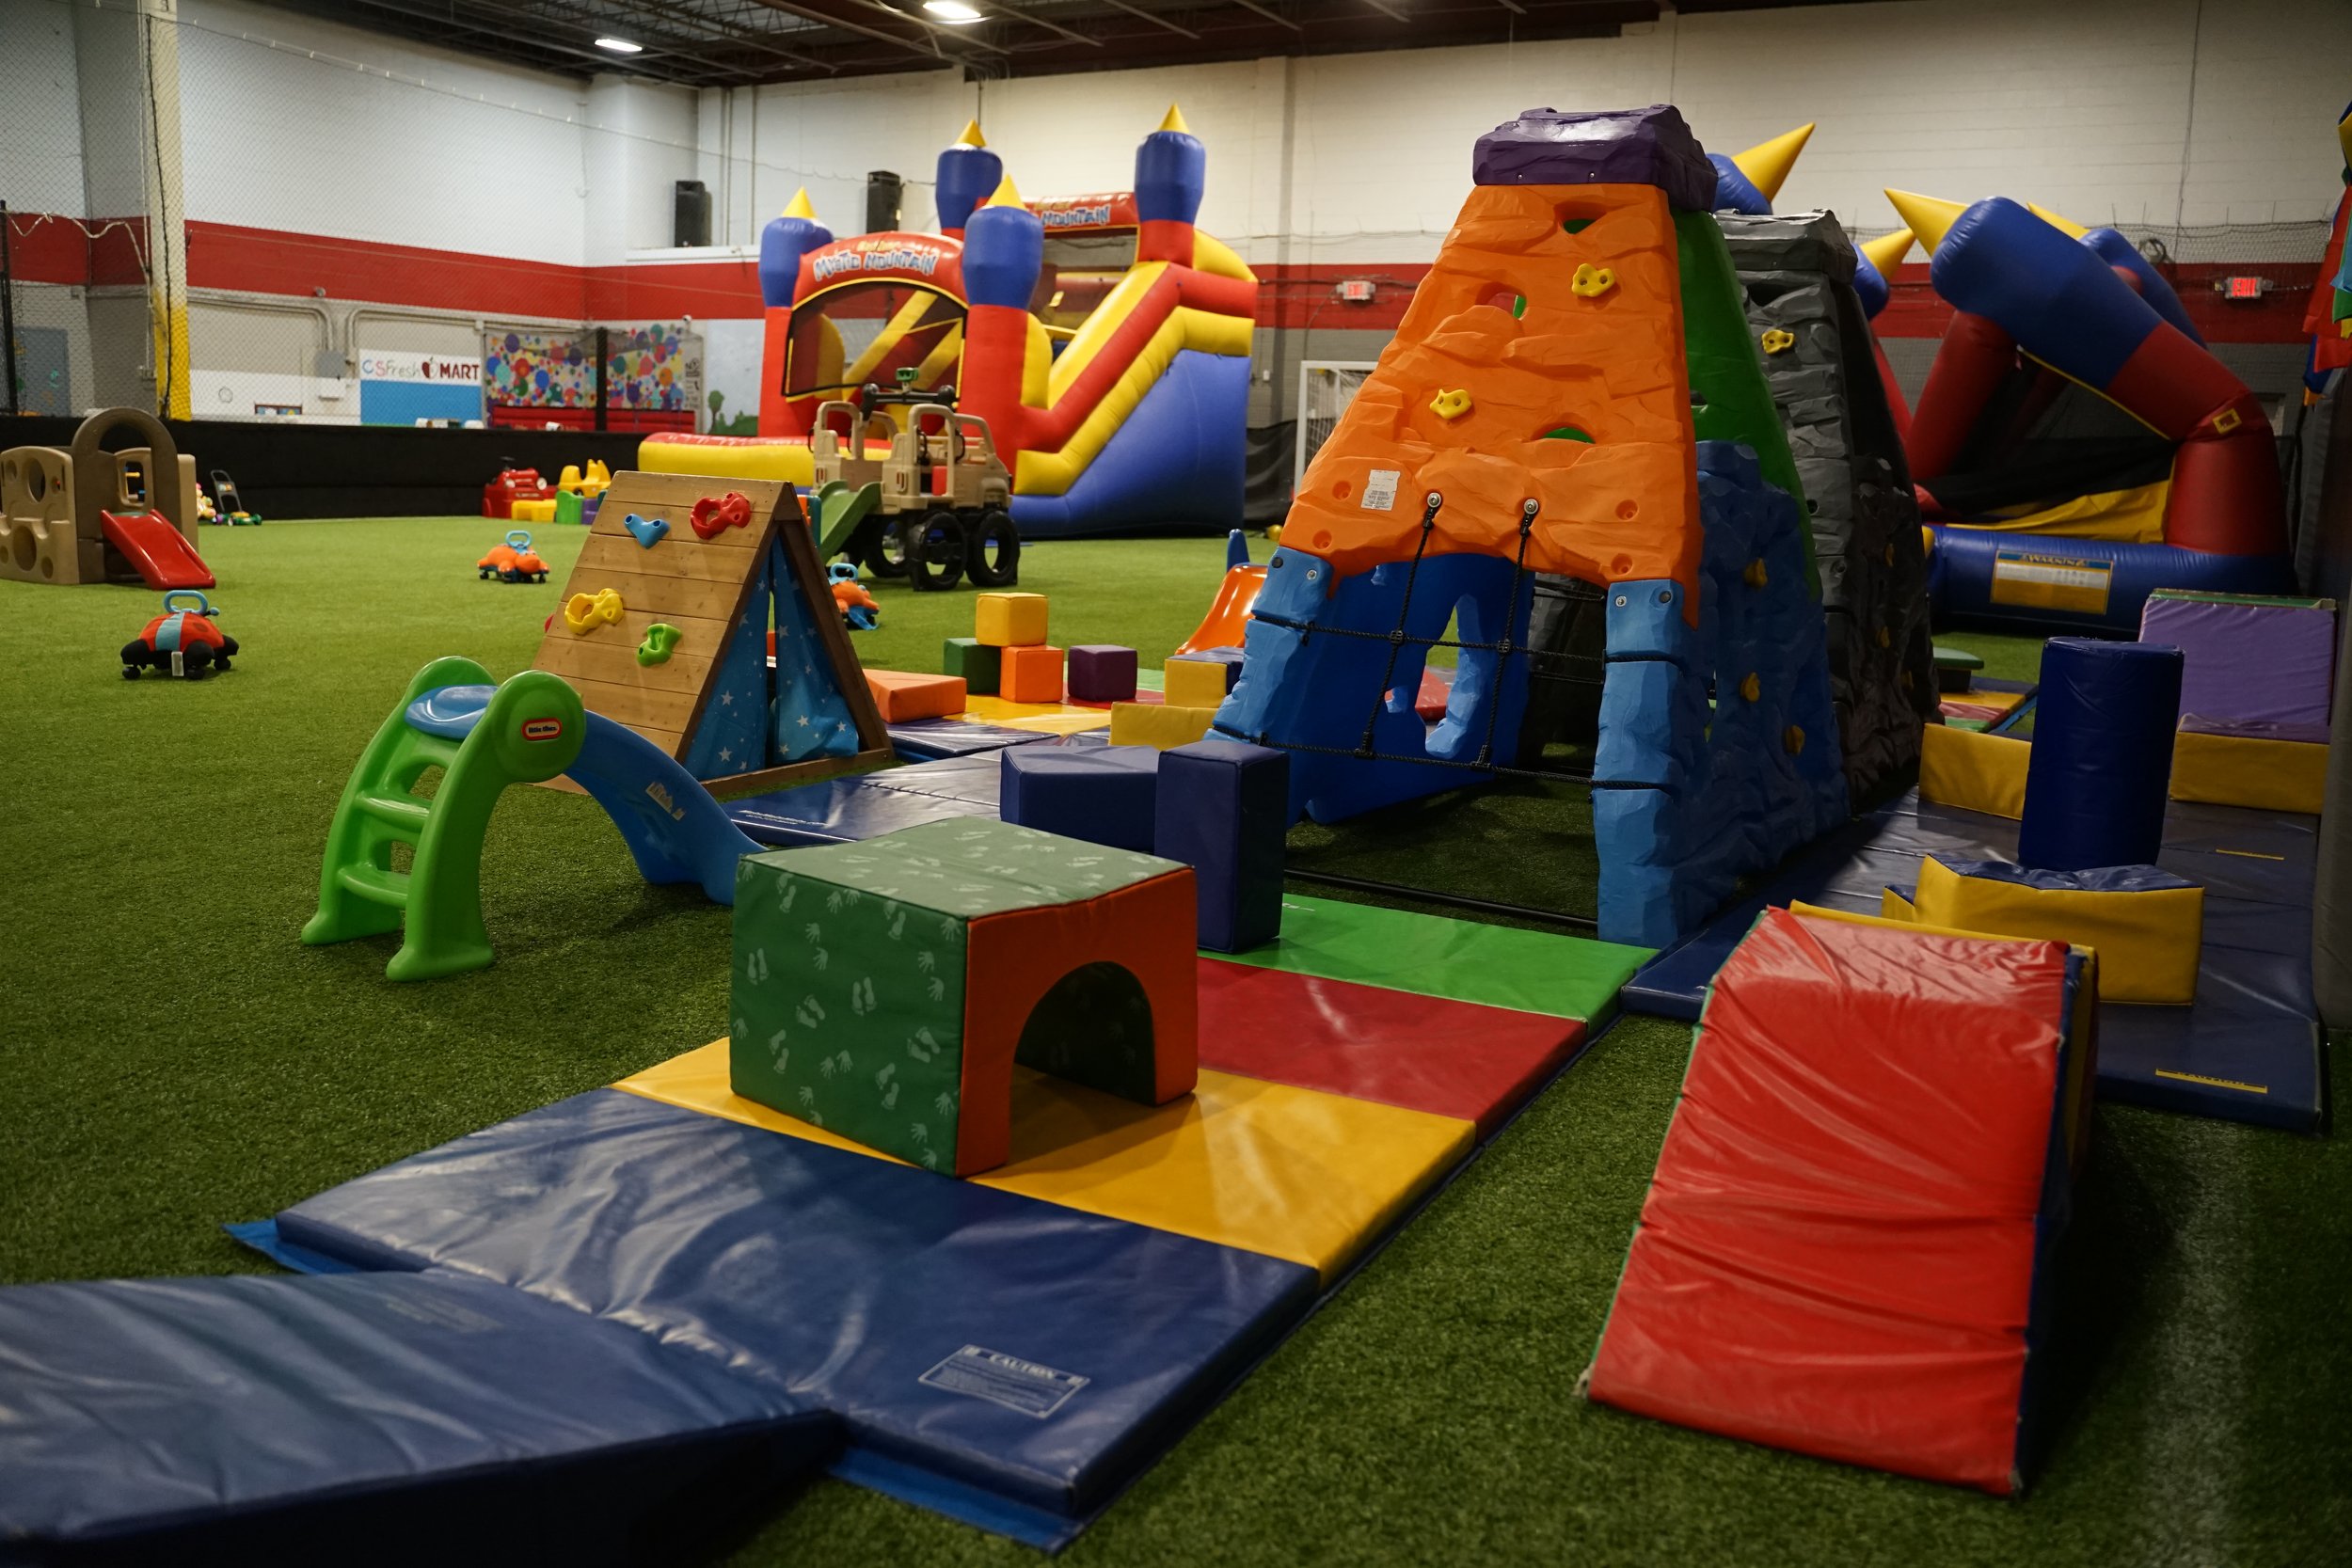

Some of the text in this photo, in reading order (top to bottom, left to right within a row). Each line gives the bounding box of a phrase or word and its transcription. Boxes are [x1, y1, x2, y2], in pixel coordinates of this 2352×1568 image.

[863, 249, 938, 276] MOUNTAIN
[439, 363, 480, 380] MART
[2026, 554, 2087, 568] WARNING
[989, 1353, 1057, 1381] CAUTION
